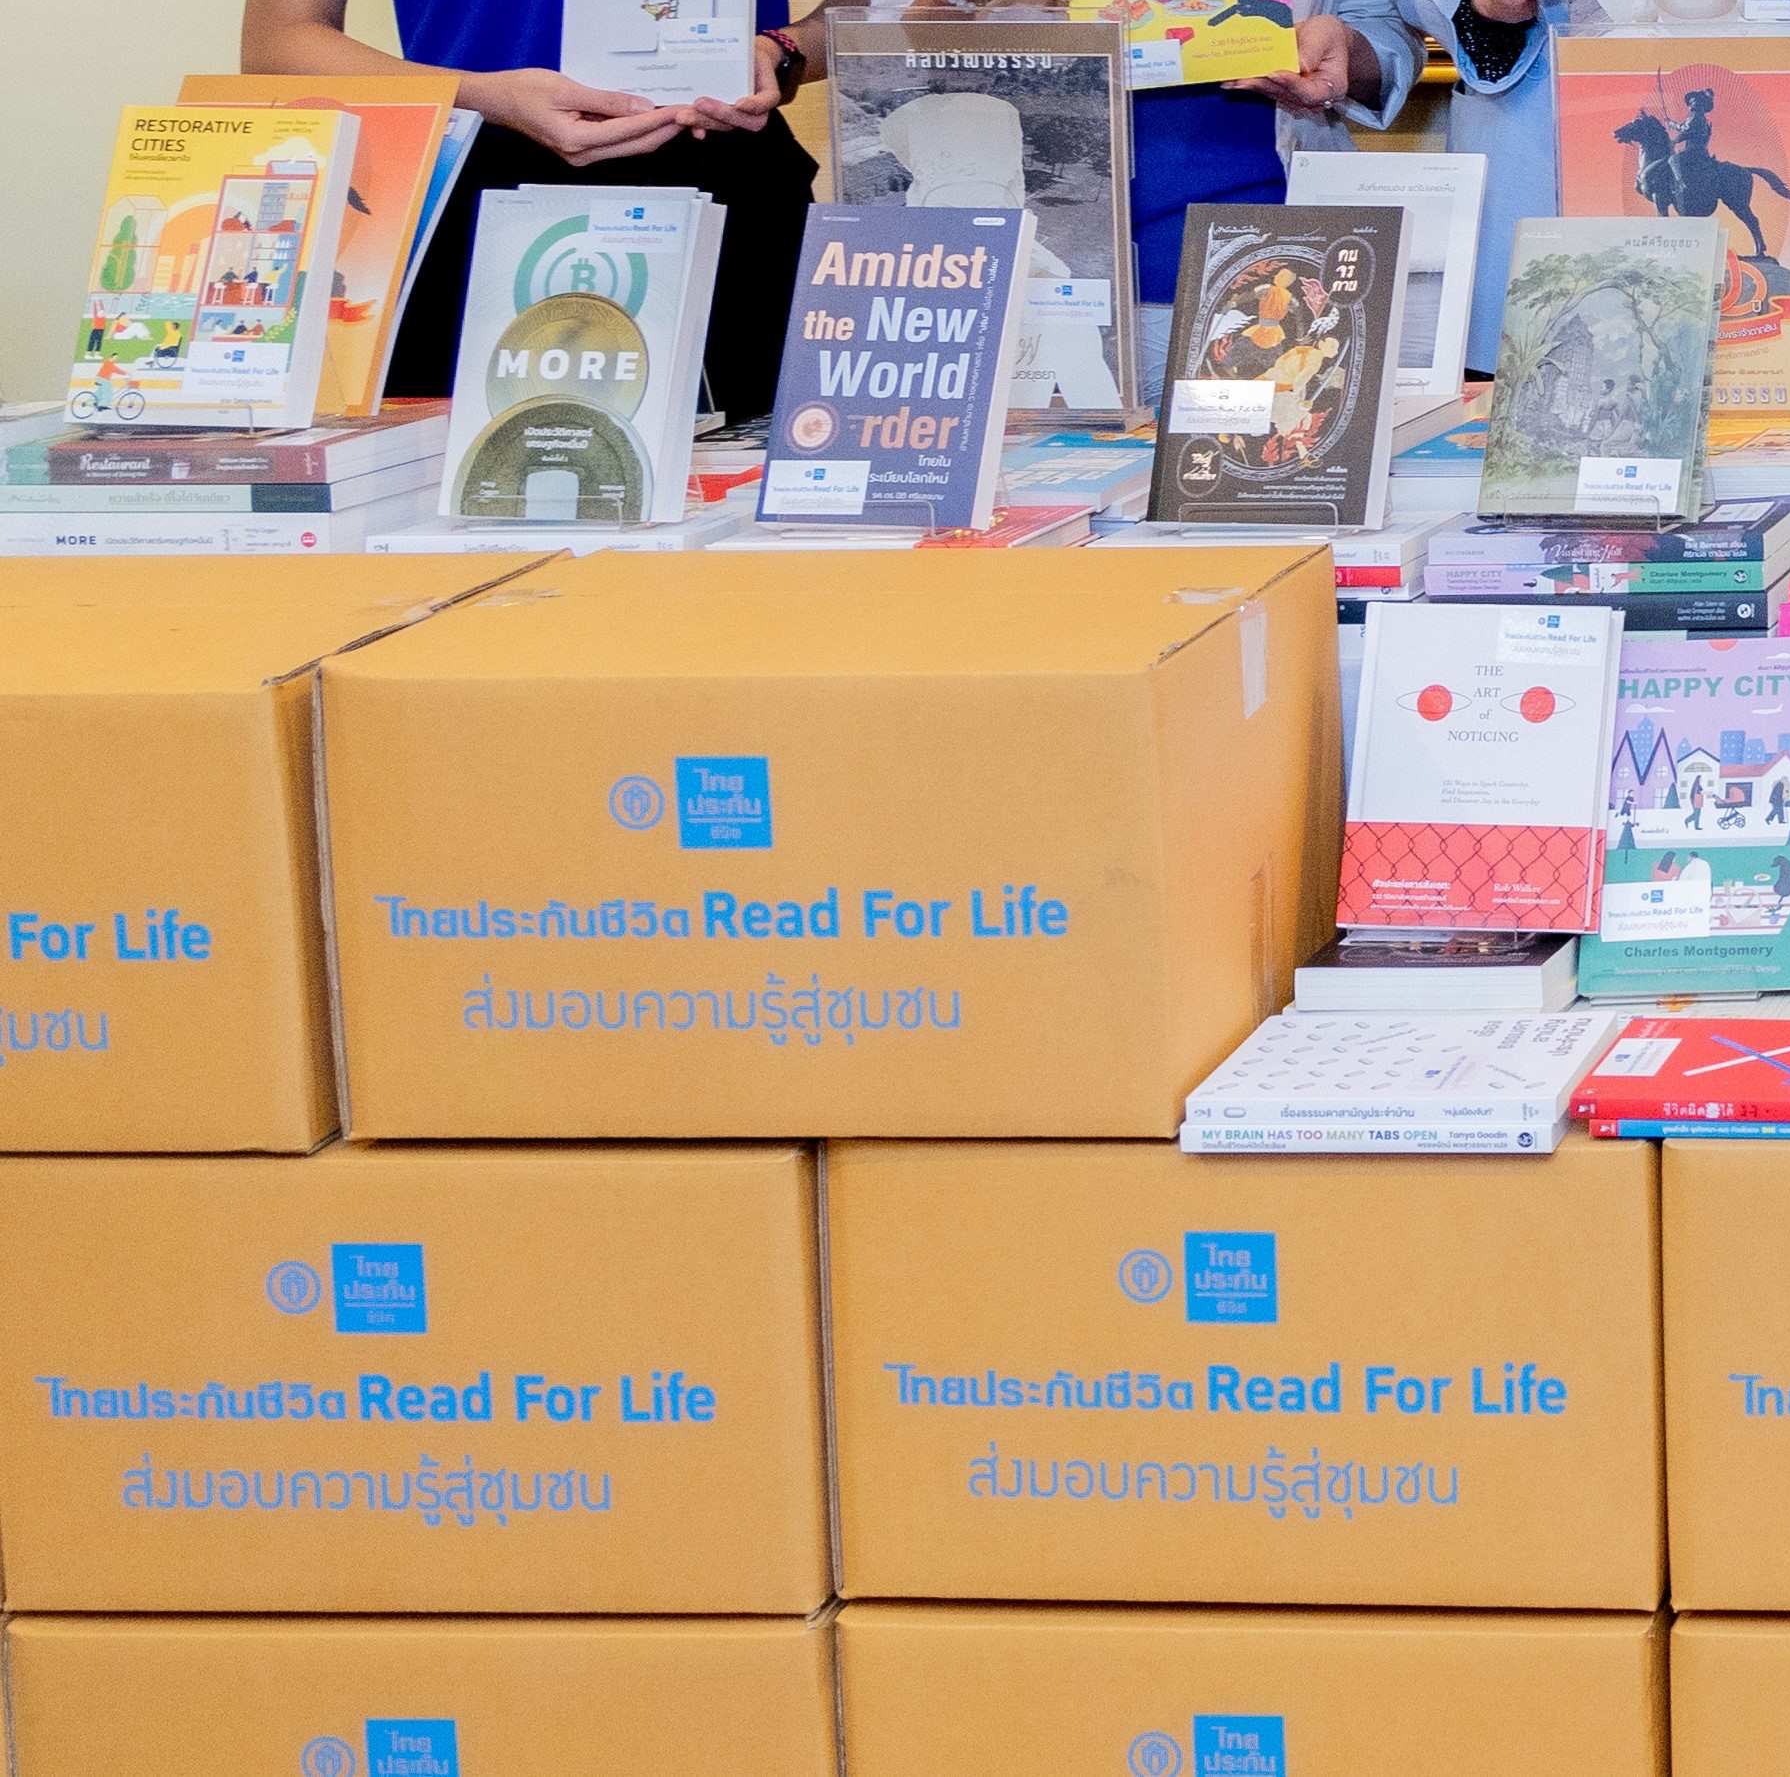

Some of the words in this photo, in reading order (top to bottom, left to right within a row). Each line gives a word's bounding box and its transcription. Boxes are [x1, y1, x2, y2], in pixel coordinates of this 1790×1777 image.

[135, 119, 254, 134] RESTORATIVE
[131, 138, 186, 153] CITIES
[811, 241, 988, 289] Amidst
[803, 309, 854, 341] the
[866, 296, 977, 343] New
[496, 349, 639, 381] MORE
[818, 349, 970, 400] World
[56, 536, 97, 545] MORE
[1474, 665, 1504, 677] THE
[1473, 687, 1500, 699] ART
[1619, 676, 1724, 700] HAPPY
[1479, 709, 1492, 721] of
[1447, 730, 1520, 744] NOTICING
[694, 767, 746, 792] ไทย
[377, 897, 692, 939] ไทยประกันชีวิต
[704, 887, 841, 940] Read
[864, 890, 953, 939] For
[971, 885, 1070, 939] Life
[1624, 946, 1680, 958] Charles
[1683, 944, 1774, 959] Montgomery
[465, 975, 961, 1047] ส่งมอบความรู้สู่ชุมชน
[1201, 1129, 1222, 1141] MY
[1224, 1129, 1264, 1141] BRAIN
[1267, 1129, 1293, 1141] HAS
[1296, 1129, 1324, 1141] TOO
[1327, 1129, 1365, 1141] MANY
[1369, 1129, 1400, 1141] TABS
[1403, 1129, 1438, 1141] OPEN
[1449, 1130, 1475, 1142] Tanya
[1476, 1129, 1508, 1140] Goodin
[37, 1378, 348, 1421] ไทยประกันชีวิต
[359, 1372, 494, 1423] Read
[515, 1375, 603, 1423] For
[621, 1372, 717, 1423] Life
[124, 1455, 612, 1527] ส่งมอบความรู้สู่ชุมชน
